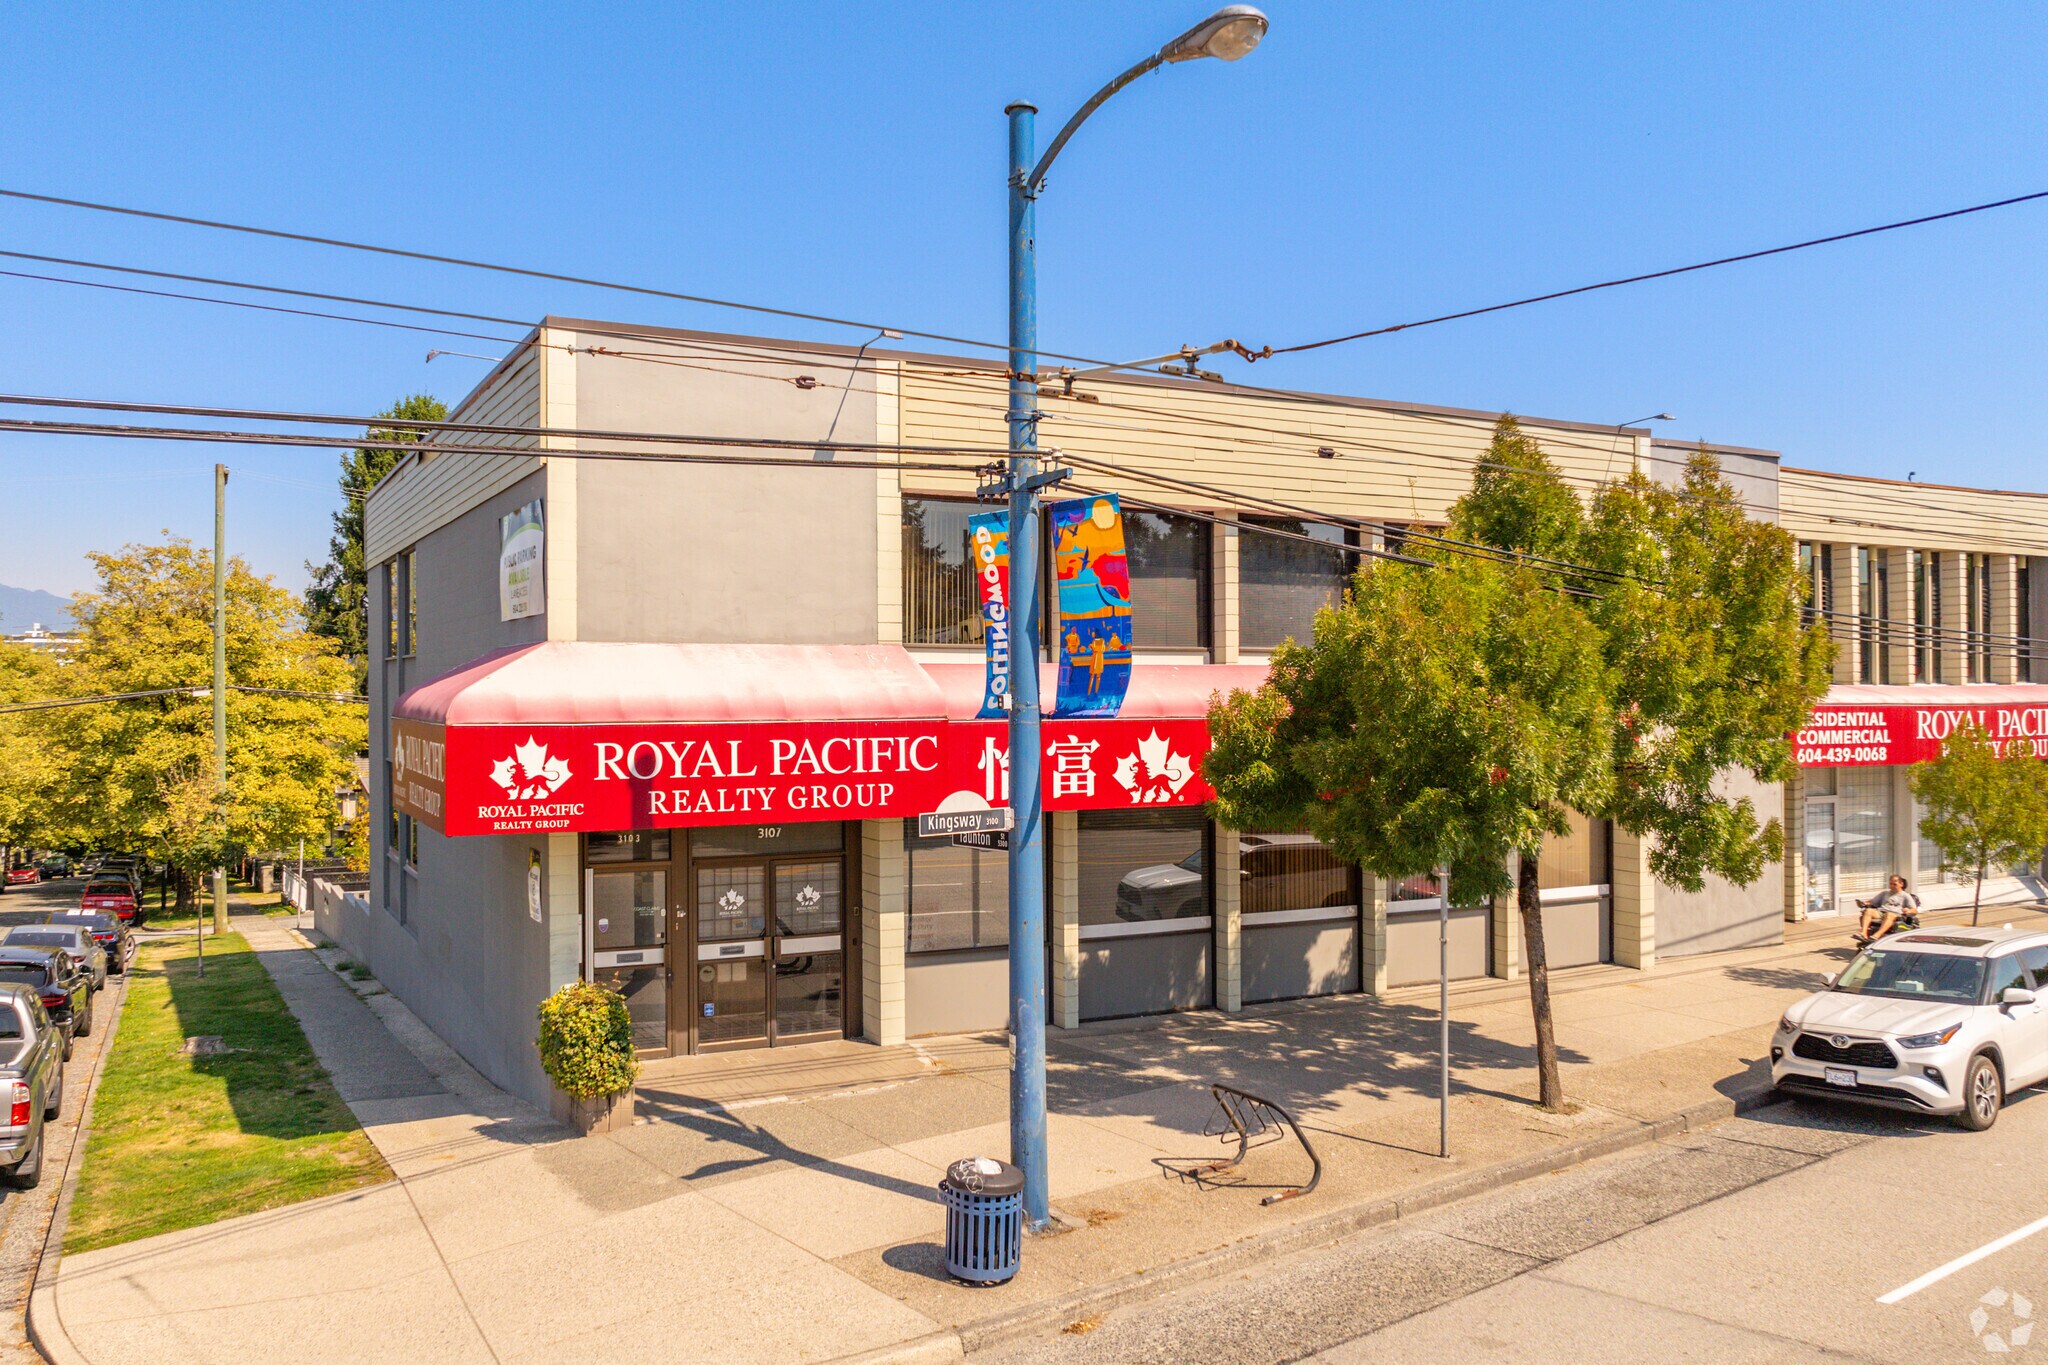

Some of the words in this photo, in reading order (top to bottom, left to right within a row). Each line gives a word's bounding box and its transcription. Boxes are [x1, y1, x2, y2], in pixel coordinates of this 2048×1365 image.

[1796, 729, 1892, 745] COMMERCIAL
[593, 740, 758, 781] ROYAL
[769, 735, 938, 776] PACIFIC
[1796, 747, 1887, 763] 604-439-0068
[648, 787, 777, 815] REALTY
[787, 783, 894, 810] GROUP
[478, 805, 527, 819] ROYAL
[529, 803, 584, 817] PACIFIC
[493, 821, 532, 830] REALTY
[535, 819, 570, 829] GROUP
[928, 814, 982, 832] Kingsway
[986, 817, 999, 826] 3100
[618, 834, 641, 843] 3103
[758, 827, 782, 838] 3107
